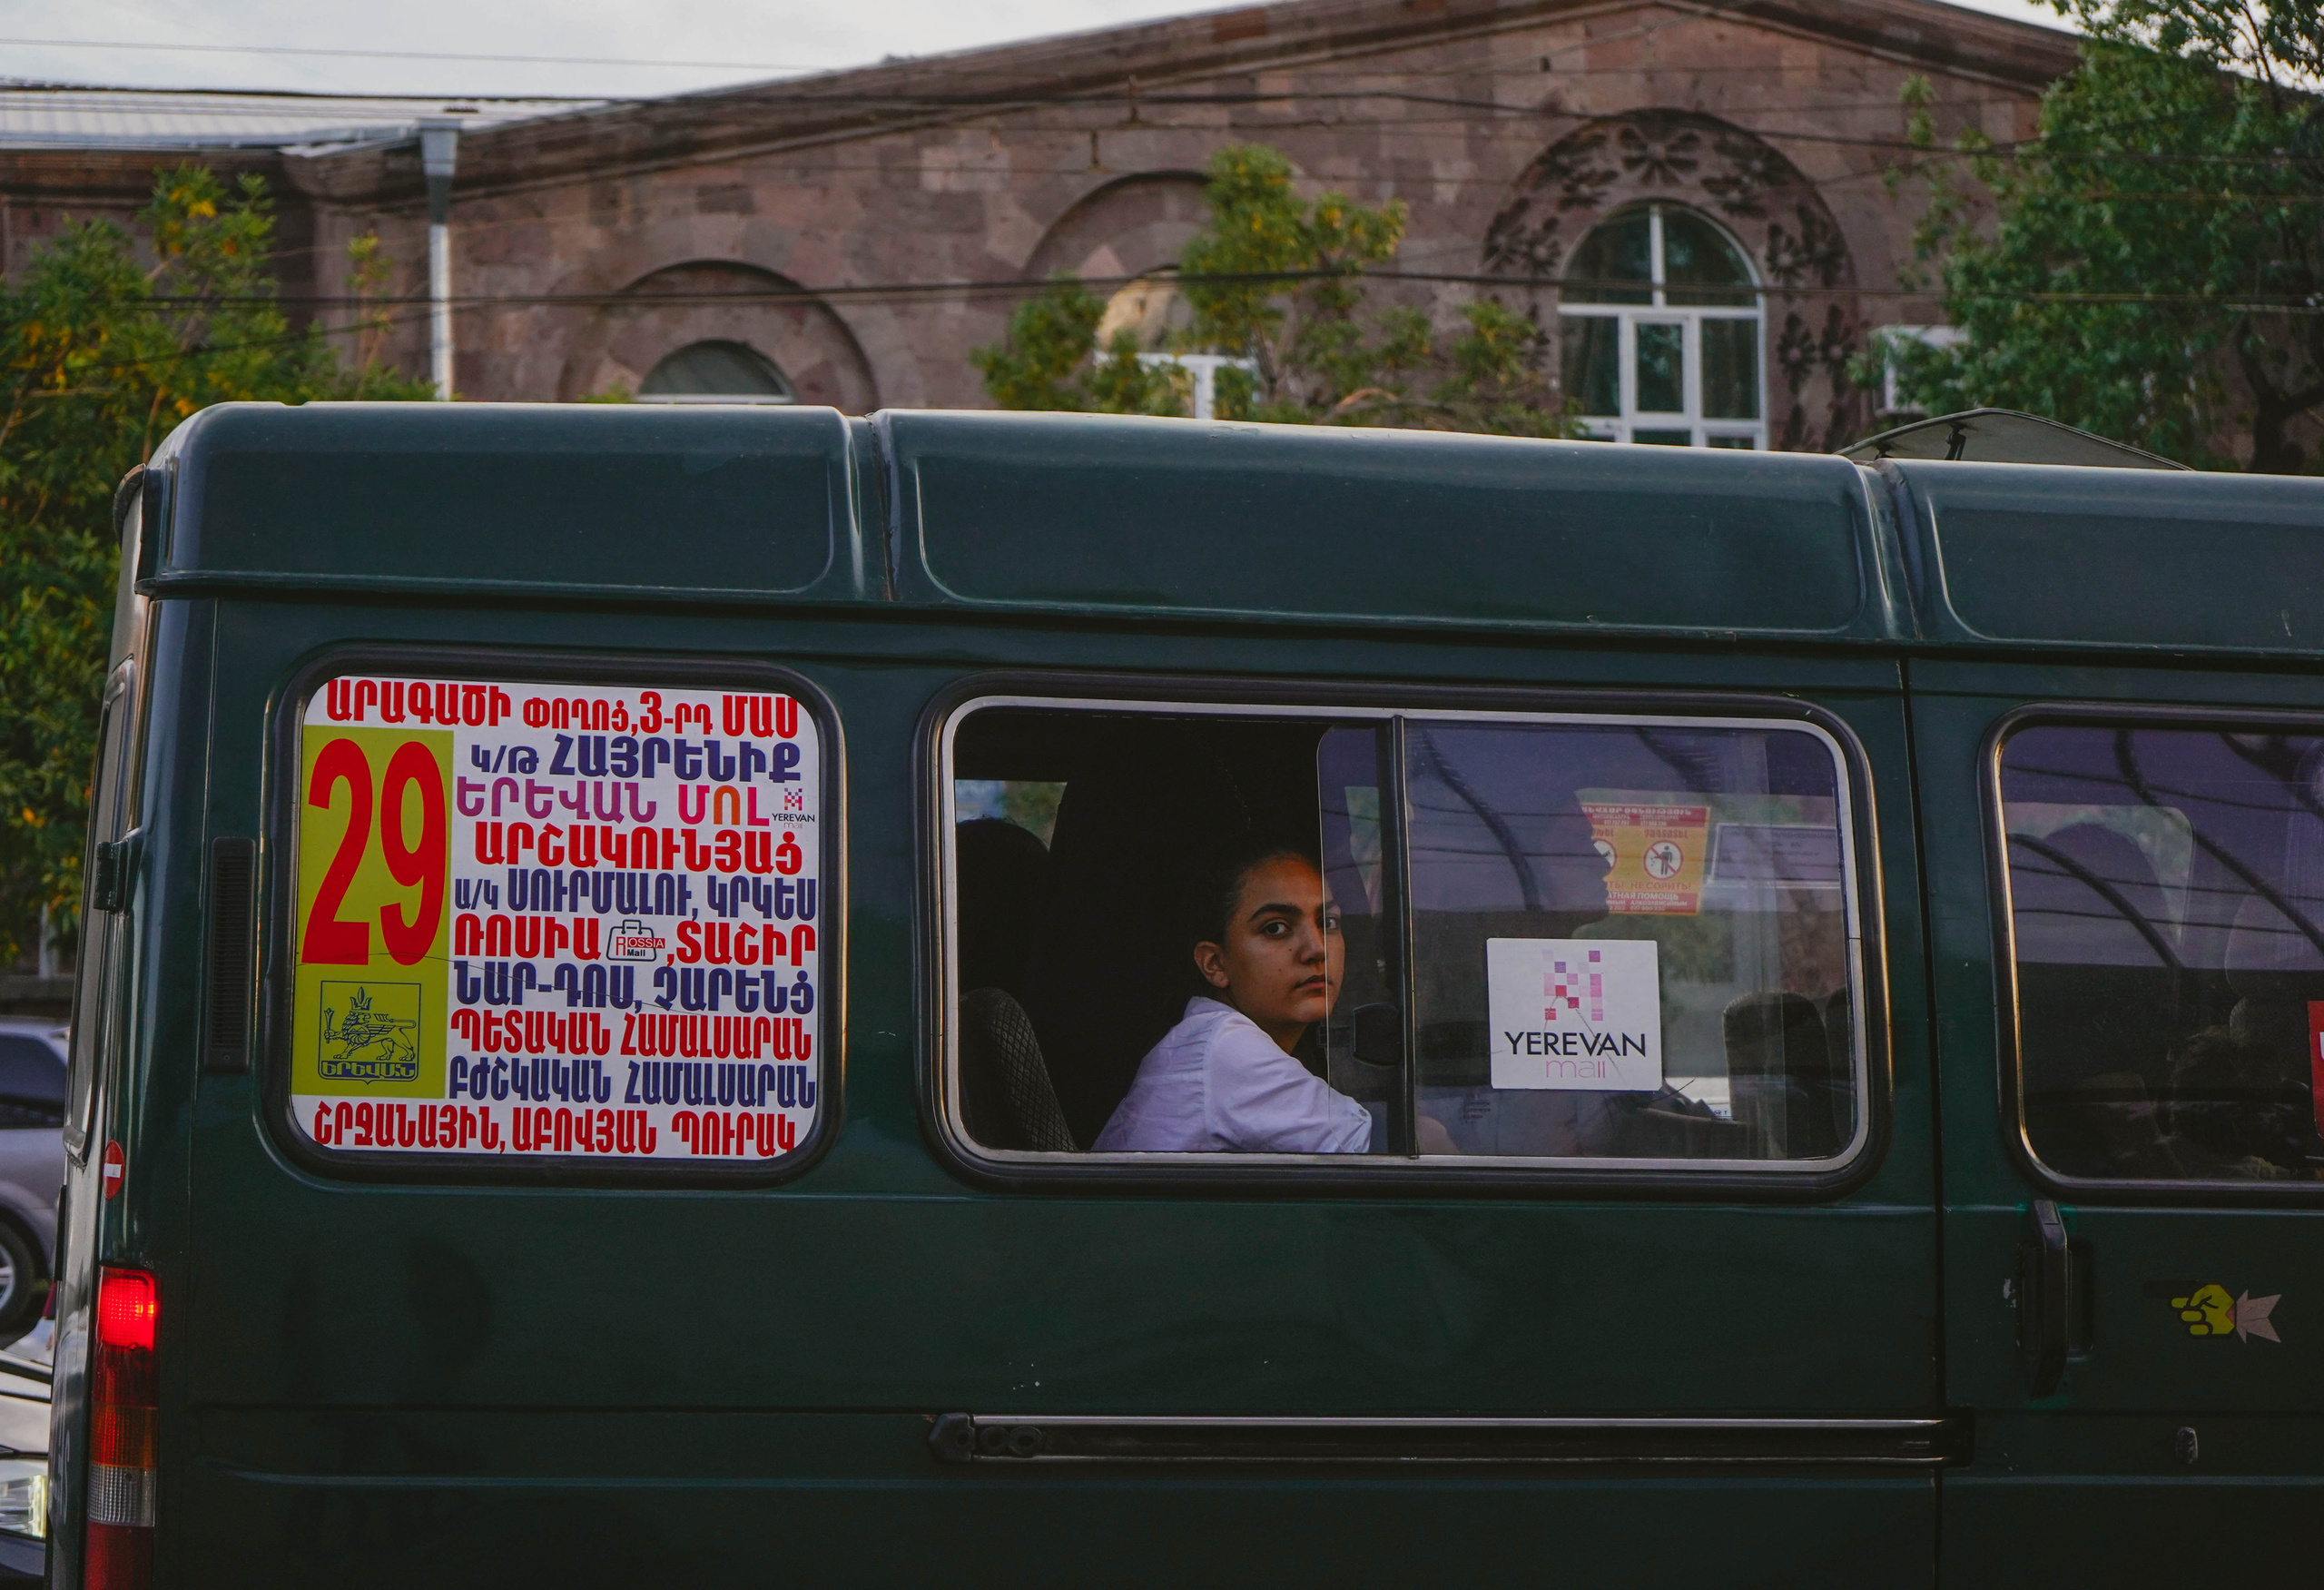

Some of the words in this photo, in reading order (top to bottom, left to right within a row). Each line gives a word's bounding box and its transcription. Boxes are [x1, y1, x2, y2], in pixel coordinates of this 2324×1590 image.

[327, 679, 510, 728] ԱՐԱԳԱԾԻ
[723, 696, 798, 738] ՄԱՍ
[549, 734, 801, 783] ՀԱՅՐԵՆԻՔ
[457, 775, 656, 824] ԵՐԵՎԱՆ
[678, 785, 770, 826] ՄՈԼ
[772, 813, 815, 823] YEREVAN
[301, 738, 447, 966] 29
[476, 822, 803, 874] ԱՐՇԱԿՈՒՆՅԱՑ
[507, 869, 699, 921] ՍՈՒՐՄԱԼՈՒ,
[707, 875, 817, 921] ԿՐԿԵՍ
[1630, 881, 1644, 890] НЕ
[1646, 882, 1691, 891] СОРИТЬ!
[1637, 893, 1679, 901] ПОМОЩЬ
[455, 914, 601, 960] ՌՈՍԻԱ
[615, 936, 665, 956] ROSSIA
[626, 949, 645, 957] Mall
[454, 961, 642, 1013] ՆԱՐ-ԴՈՍ,
[654, 966, 814, 1014] ՉԱՐԵՆՑ
[451, 1009, 610, 1055] ՊԵՏԱԿԱՆ
[621, 1013, 812, 1061] ՀԱՄԱԼՍԱՐԱՆ
[1504, 1031, 1646, 1057] YEREVAN
[449, 1056, 611, 1104] ԲԺՇԿԱԿԱՆ
[625, 1061, 815, 1109] ՀԱՄԱԼՍԱՐԱՆ
[1545, 1060, 1606, 1079] mall
[314, 1101, 506, 1154] ՇՐՋԱՆԱՅԻՆ,
[513, 1108, 656, 1154] ԱԲՈՎՅԱՆ
[672, 1111, 795, 1157] ՊՈՒՐԱԿ
